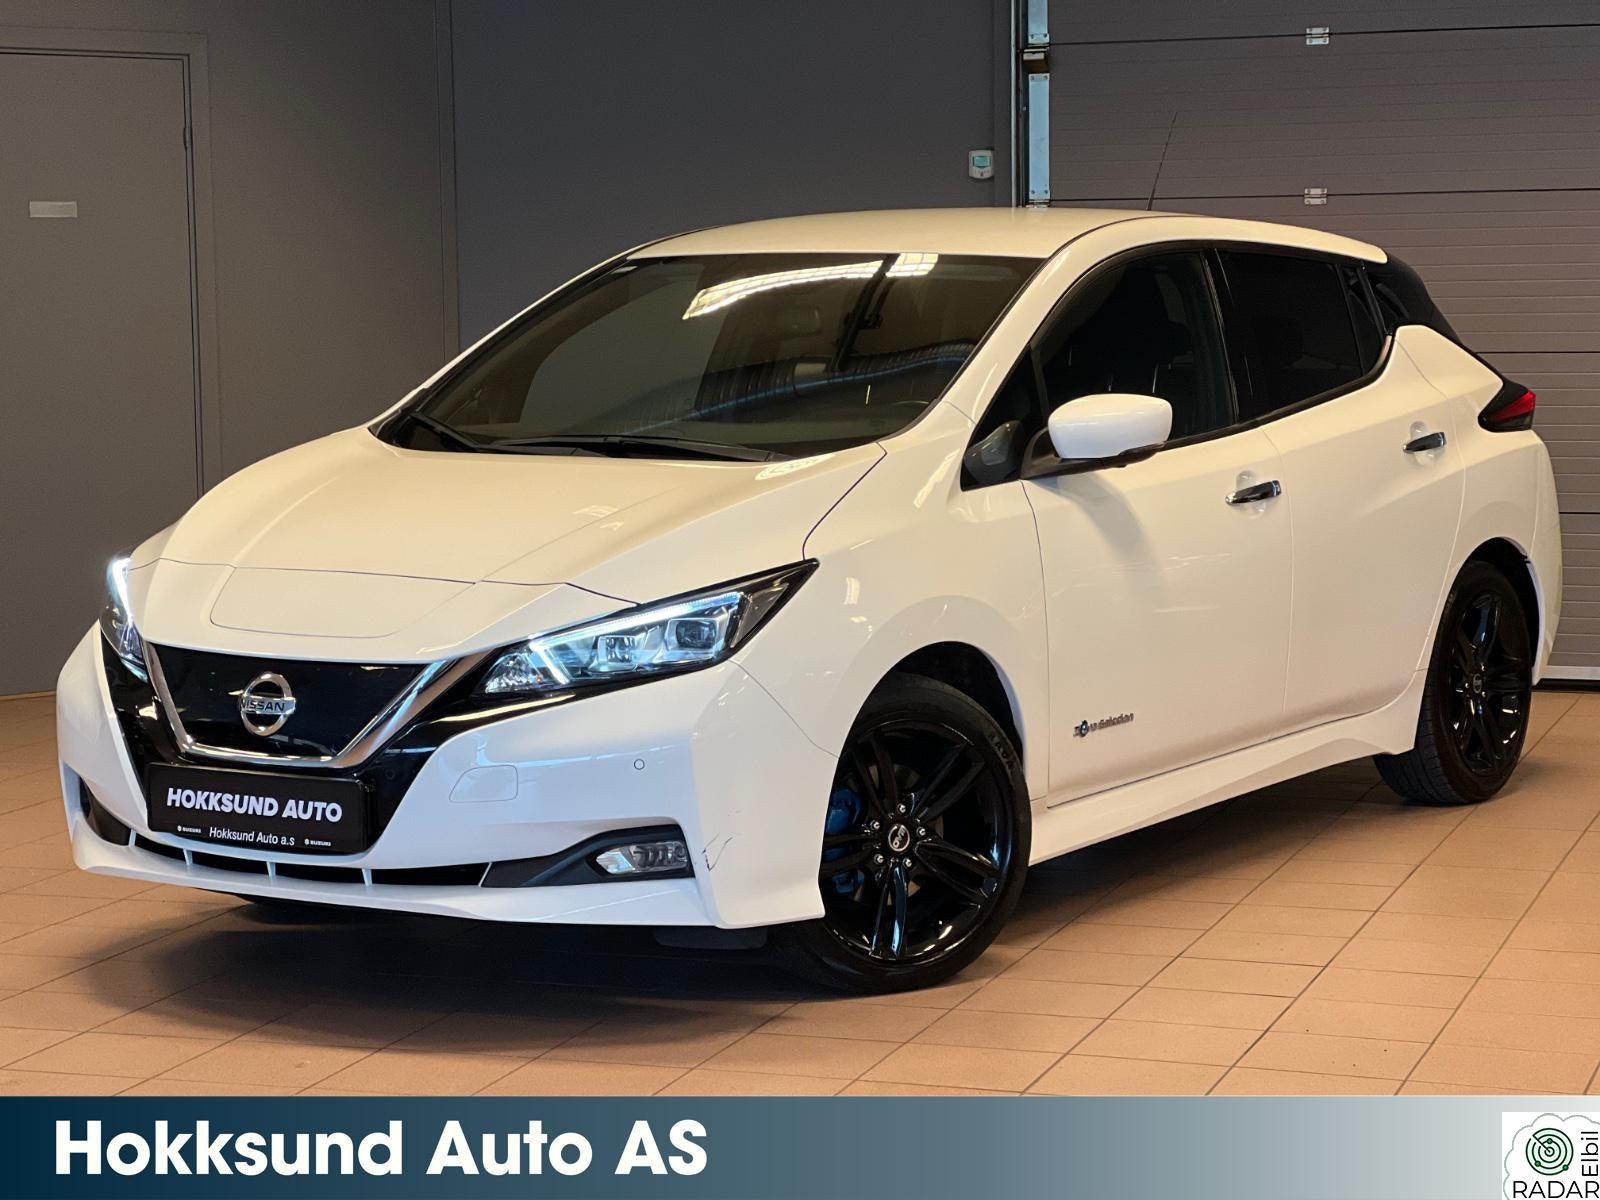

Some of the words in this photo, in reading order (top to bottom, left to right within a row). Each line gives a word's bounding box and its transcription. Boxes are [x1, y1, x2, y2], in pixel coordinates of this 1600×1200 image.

[242, 699, 286, 712] NISSAN
[166, 787, 279, 818] HOKKSUND
[282, 799, 343, 823] AUTO
[209, 826, 254, 842] Hokksund
[256, 831, 278, 845] Auto
[280, 836, 295, 846] a.s
